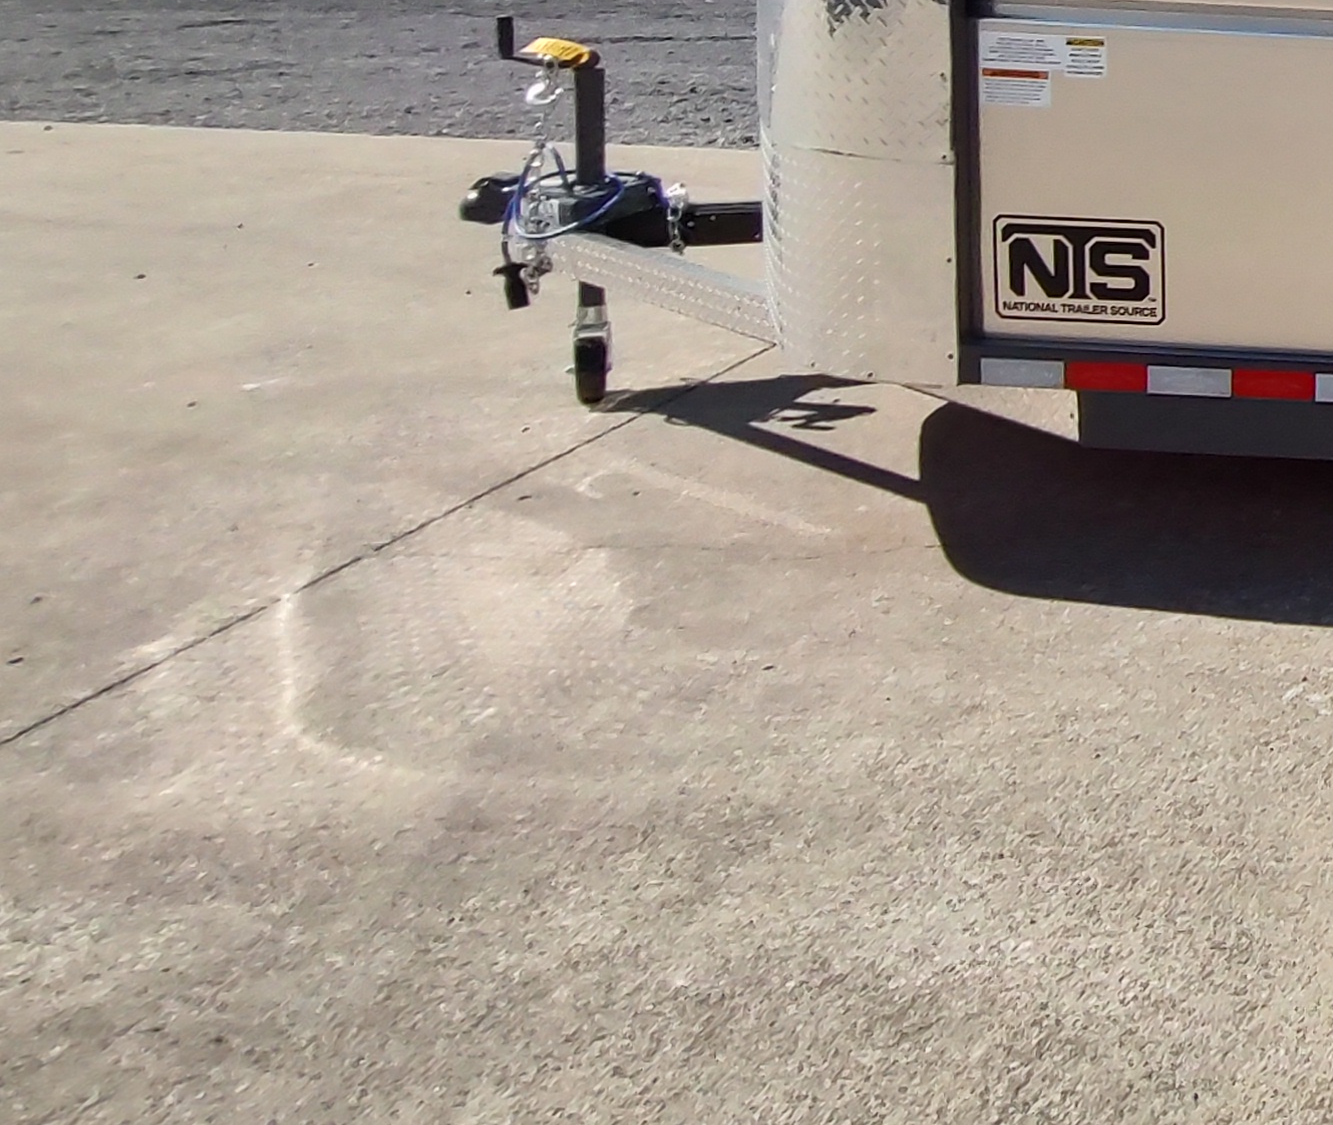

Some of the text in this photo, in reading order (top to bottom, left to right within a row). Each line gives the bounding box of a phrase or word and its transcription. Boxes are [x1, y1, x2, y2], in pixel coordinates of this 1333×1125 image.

[1001, 222, 1157, 302] NTS
[1002, 301, 1158, 318] NATIONAL TRAILER SOURCE
